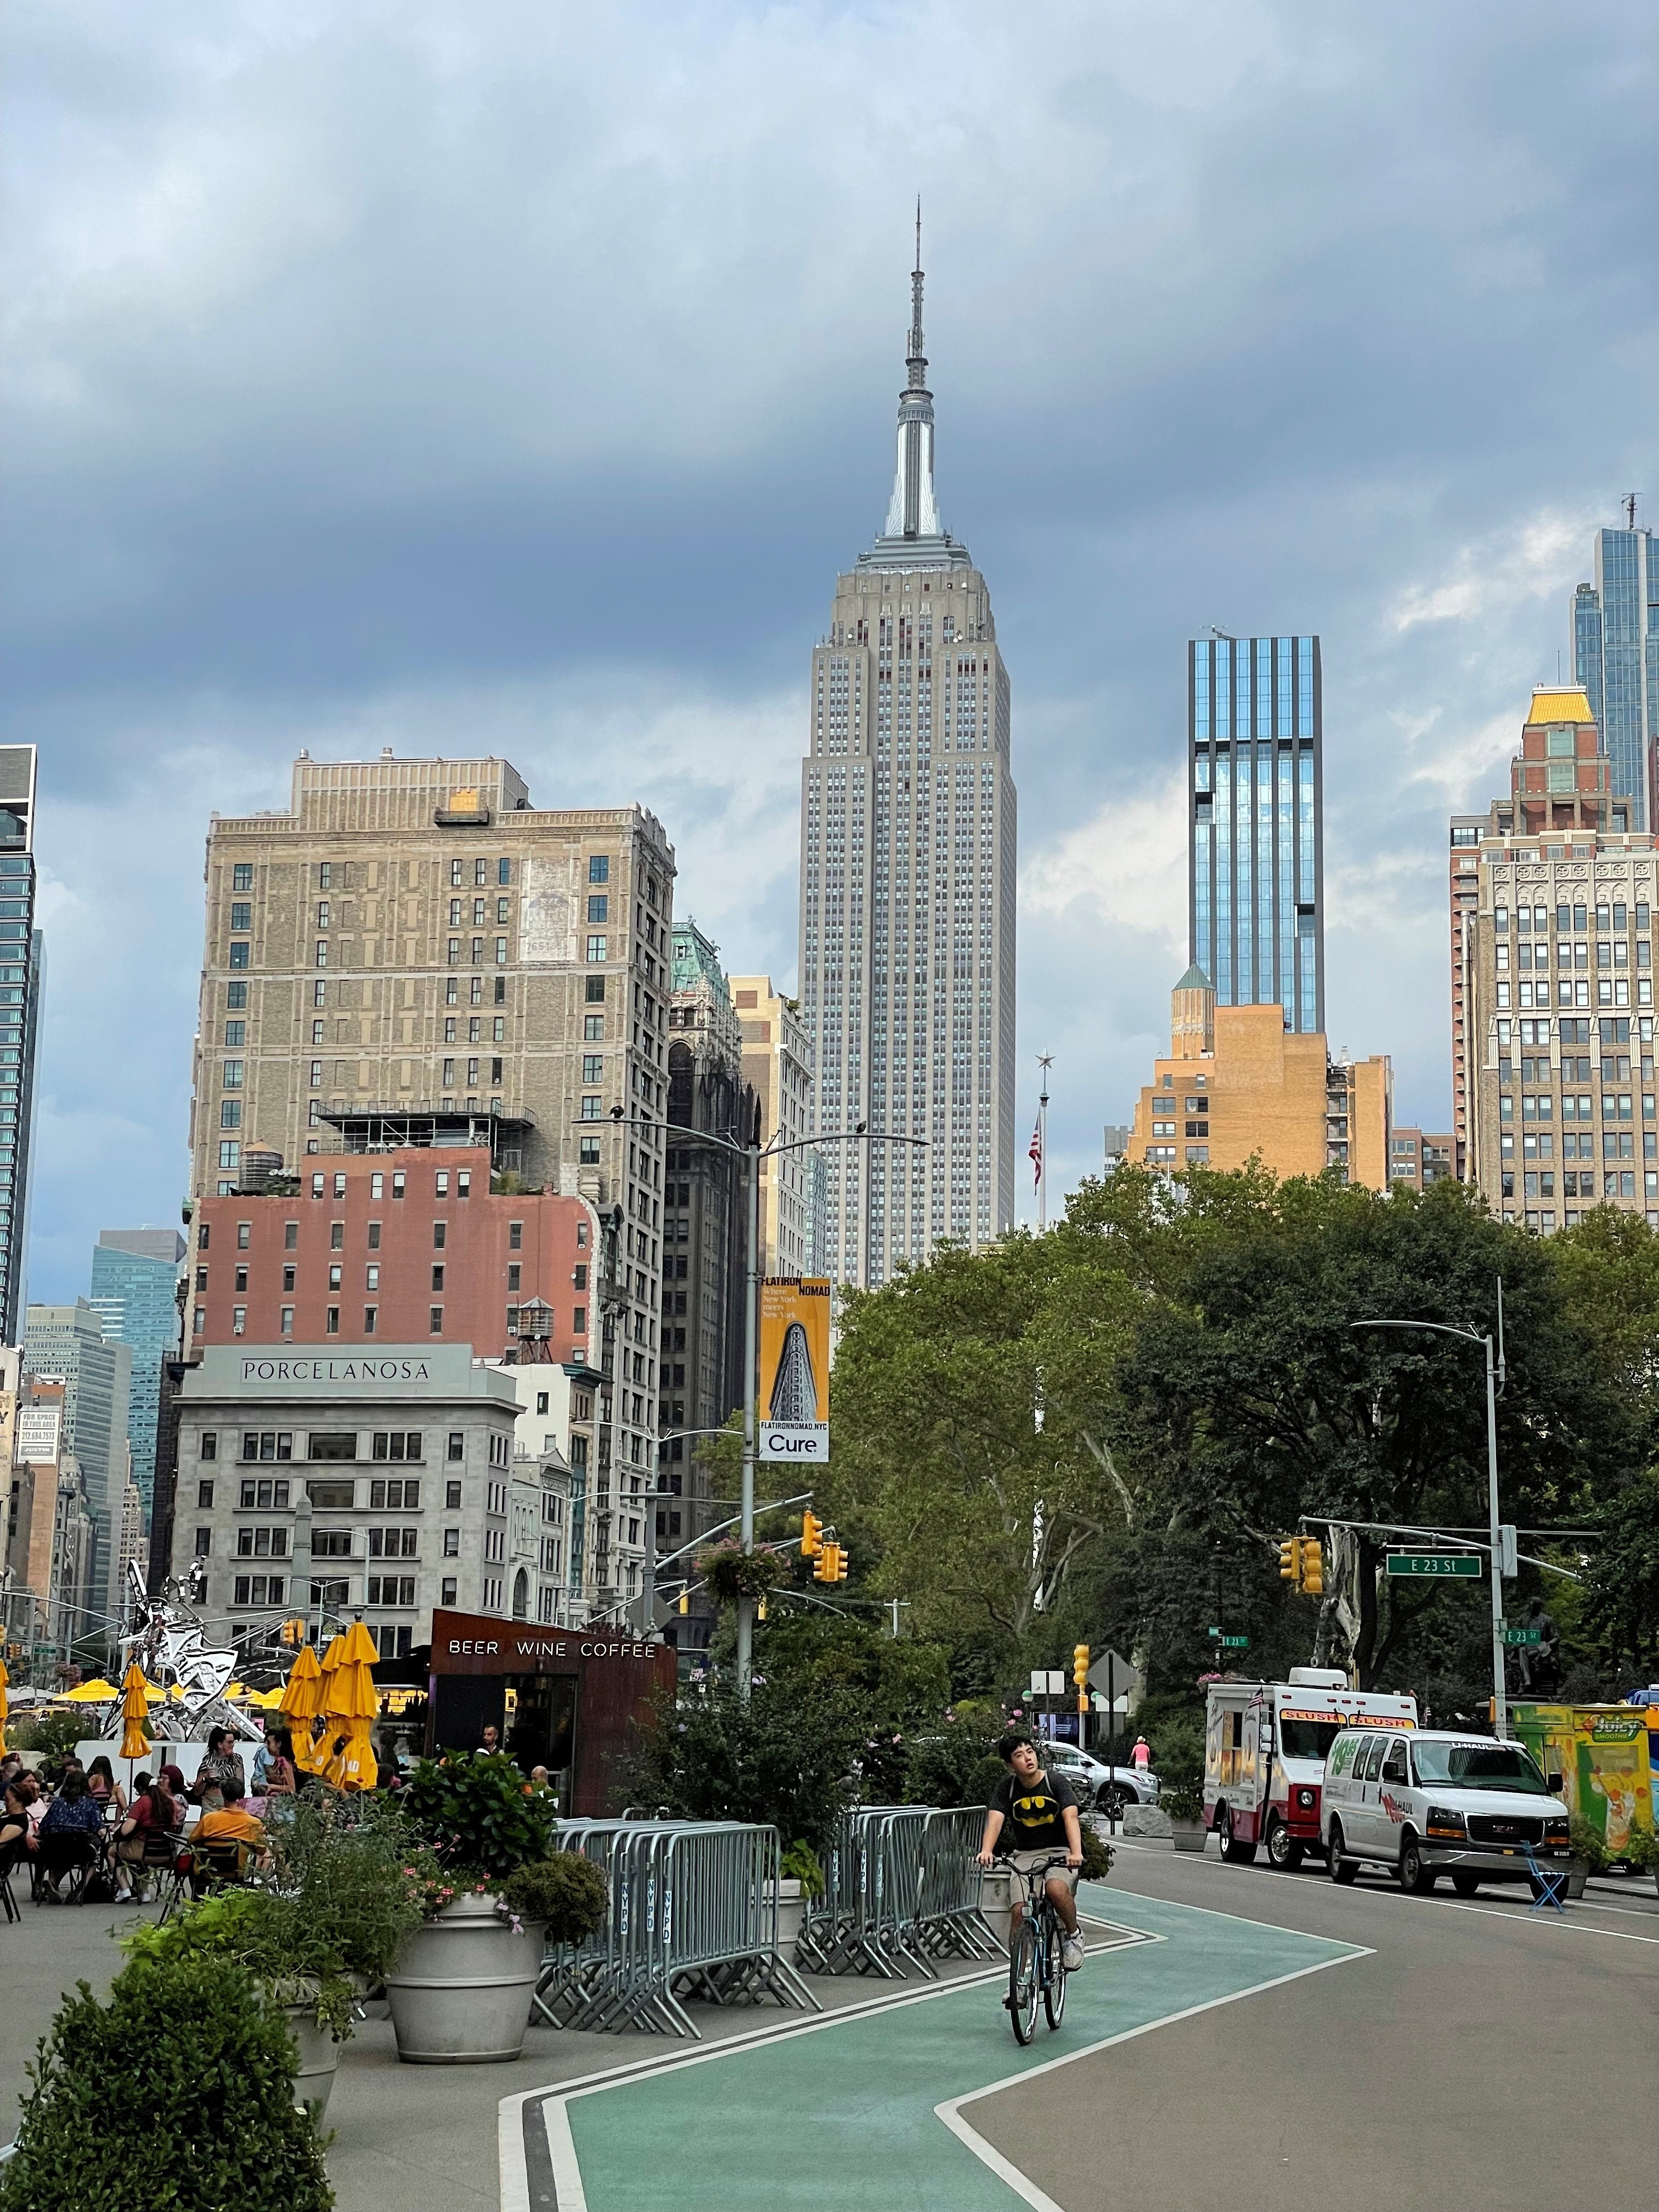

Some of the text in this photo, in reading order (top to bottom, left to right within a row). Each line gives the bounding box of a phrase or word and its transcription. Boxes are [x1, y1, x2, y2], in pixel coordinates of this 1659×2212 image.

[761, 1277, 801, 1286] FLATIRON
[799, 1285, 830, 1296] NOMAD
[244, 1362, 429, 1379] PORCELANOSA
[761, 1421, 827, 1430] FLATIRONNOMAD.NYC
[1412, 1559, 1456, 1572] E 23 St
[1508, 1631, 1513, 1641] E
[1516, 1632, 1526, 1642] 23
[449, 1640, 656, 1658] BEER WINE COFFEE
[1286, 1711, 1338, 1722] SLUSH
[1354, 1716, 1406, 1727] SLUSH
[1595, 1718, 1638, 1737] Juicy
